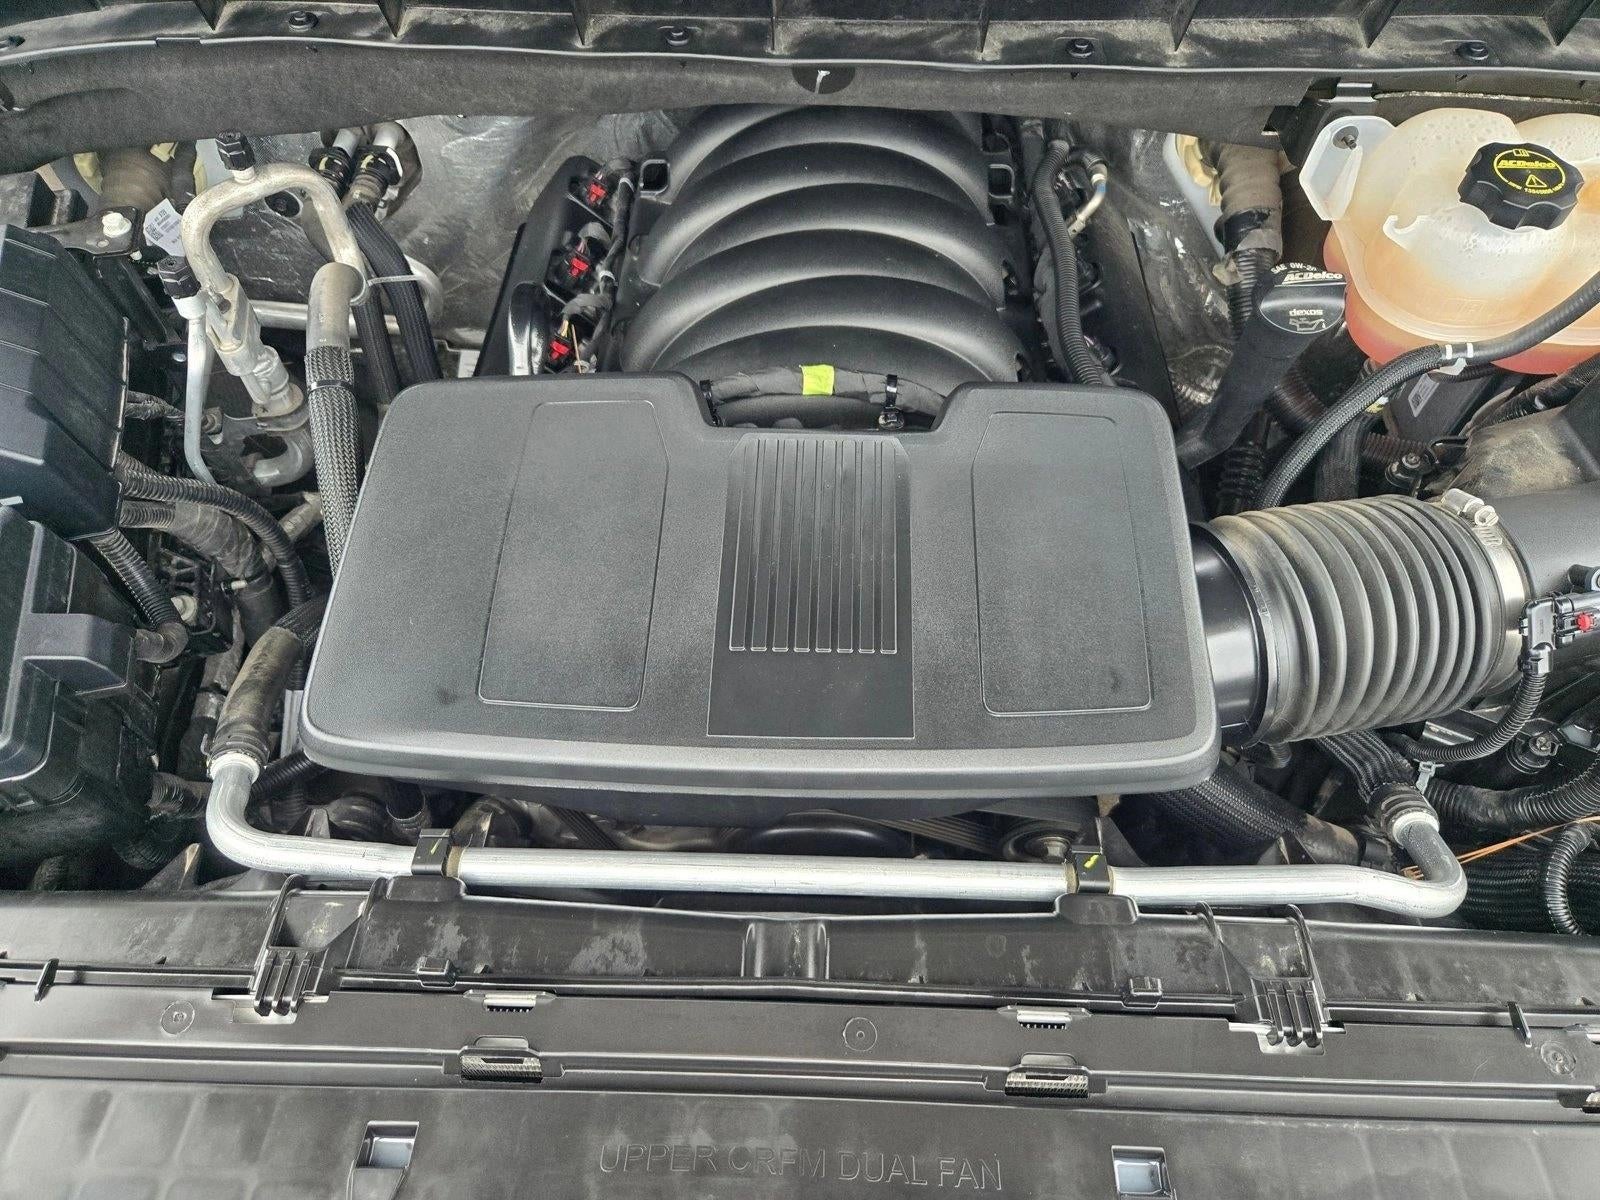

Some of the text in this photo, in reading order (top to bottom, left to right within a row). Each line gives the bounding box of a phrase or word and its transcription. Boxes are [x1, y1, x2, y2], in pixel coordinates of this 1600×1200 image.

[1271, 264, 1288, 274] SAE
[1283, 271, 1343, 282] ACDelco
[1289, 308, 1324, 317] dexos
[599, 1143, 1002, 1191] UPPER CRFM DUAL FAN
